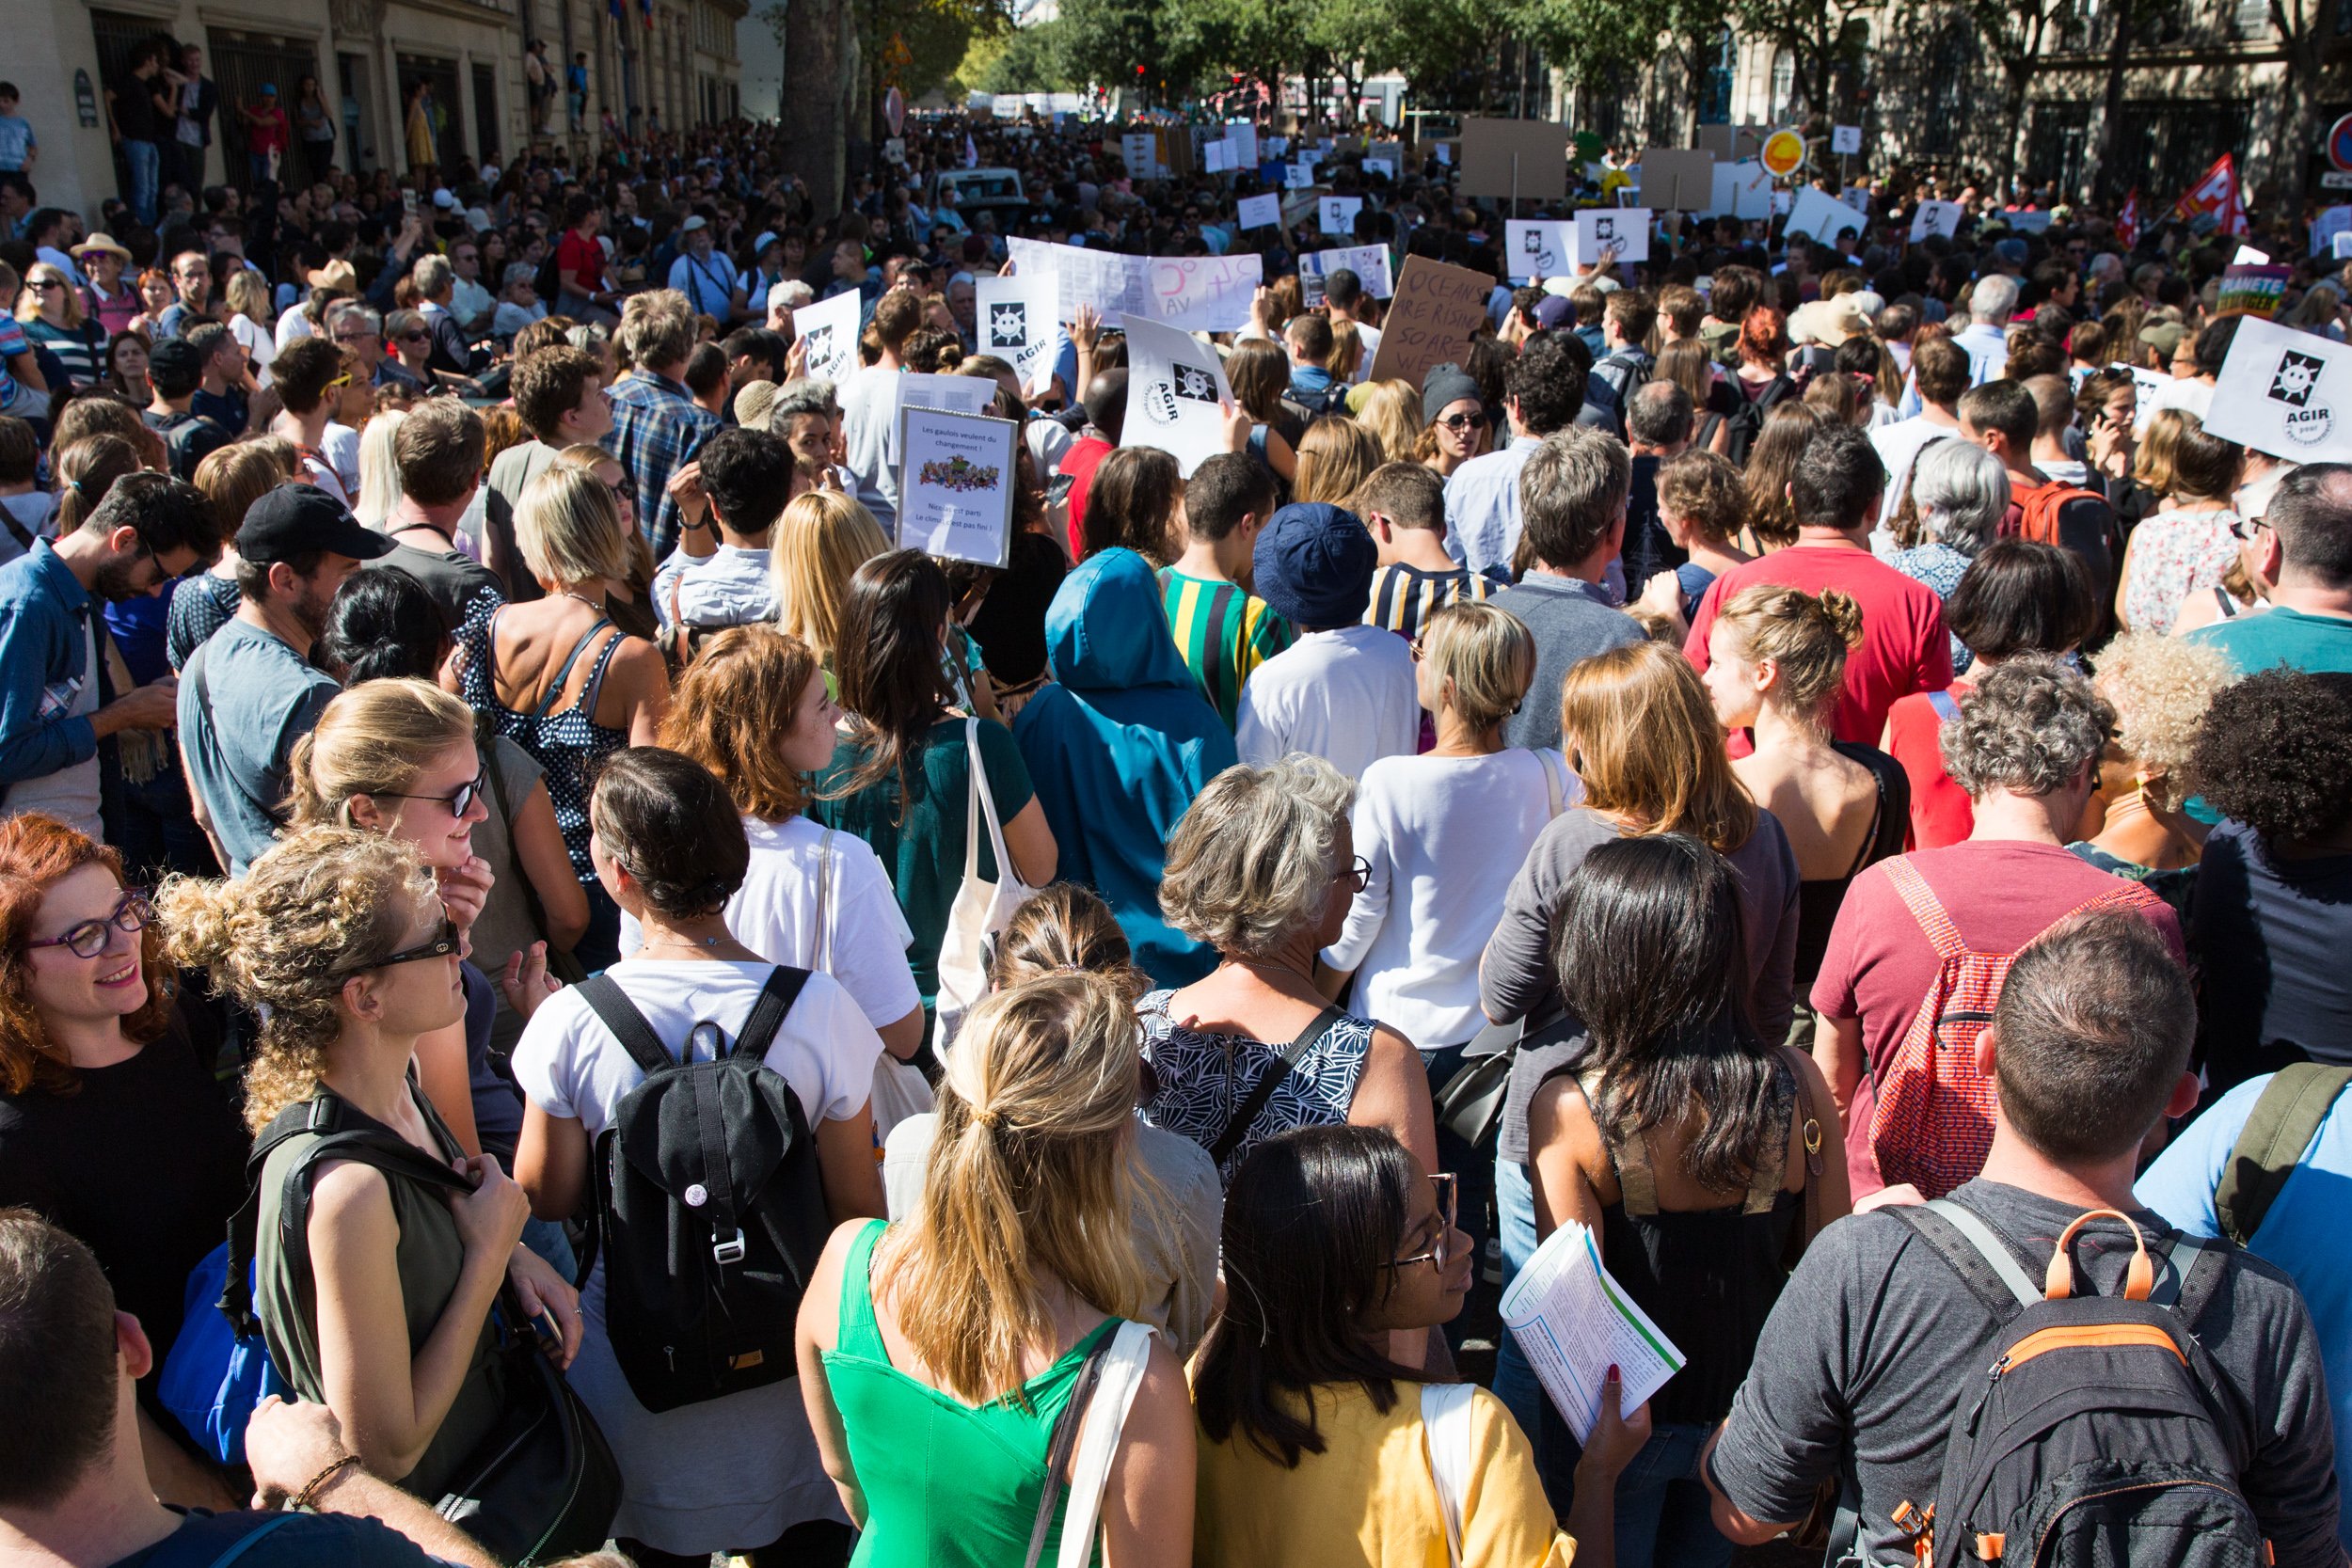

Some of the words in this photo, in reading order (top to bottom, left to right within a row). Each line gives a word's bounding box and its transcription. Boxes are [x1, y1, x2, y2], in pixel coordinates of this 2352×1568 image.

[1409, 271, 1486, 303] OCEANS
[1394, 299, 1426, 319] ARE
[1432, 302, 1478, 330] RISING
[1016, 339, 1046, 364] AGIR
[1396, 326, 1426, 345] SO
[1426, 333, 1469, 357] ARE
[827, 349, 847, 377] AGIR
[1397, 352, 1435, 372] WE
[1158, 383, 1178, 420] AGIR
[2287, 408, 2329, 423] AGIR
[934, 429, 960, 437] gaulois
[960, 433, 986, 441] veulent
[935, 439, 977, 451] changement
[928, 502, 952, 513] Nicolas
[965, 509, 981, 517] parti
[977, 522, 988, 531] fini
